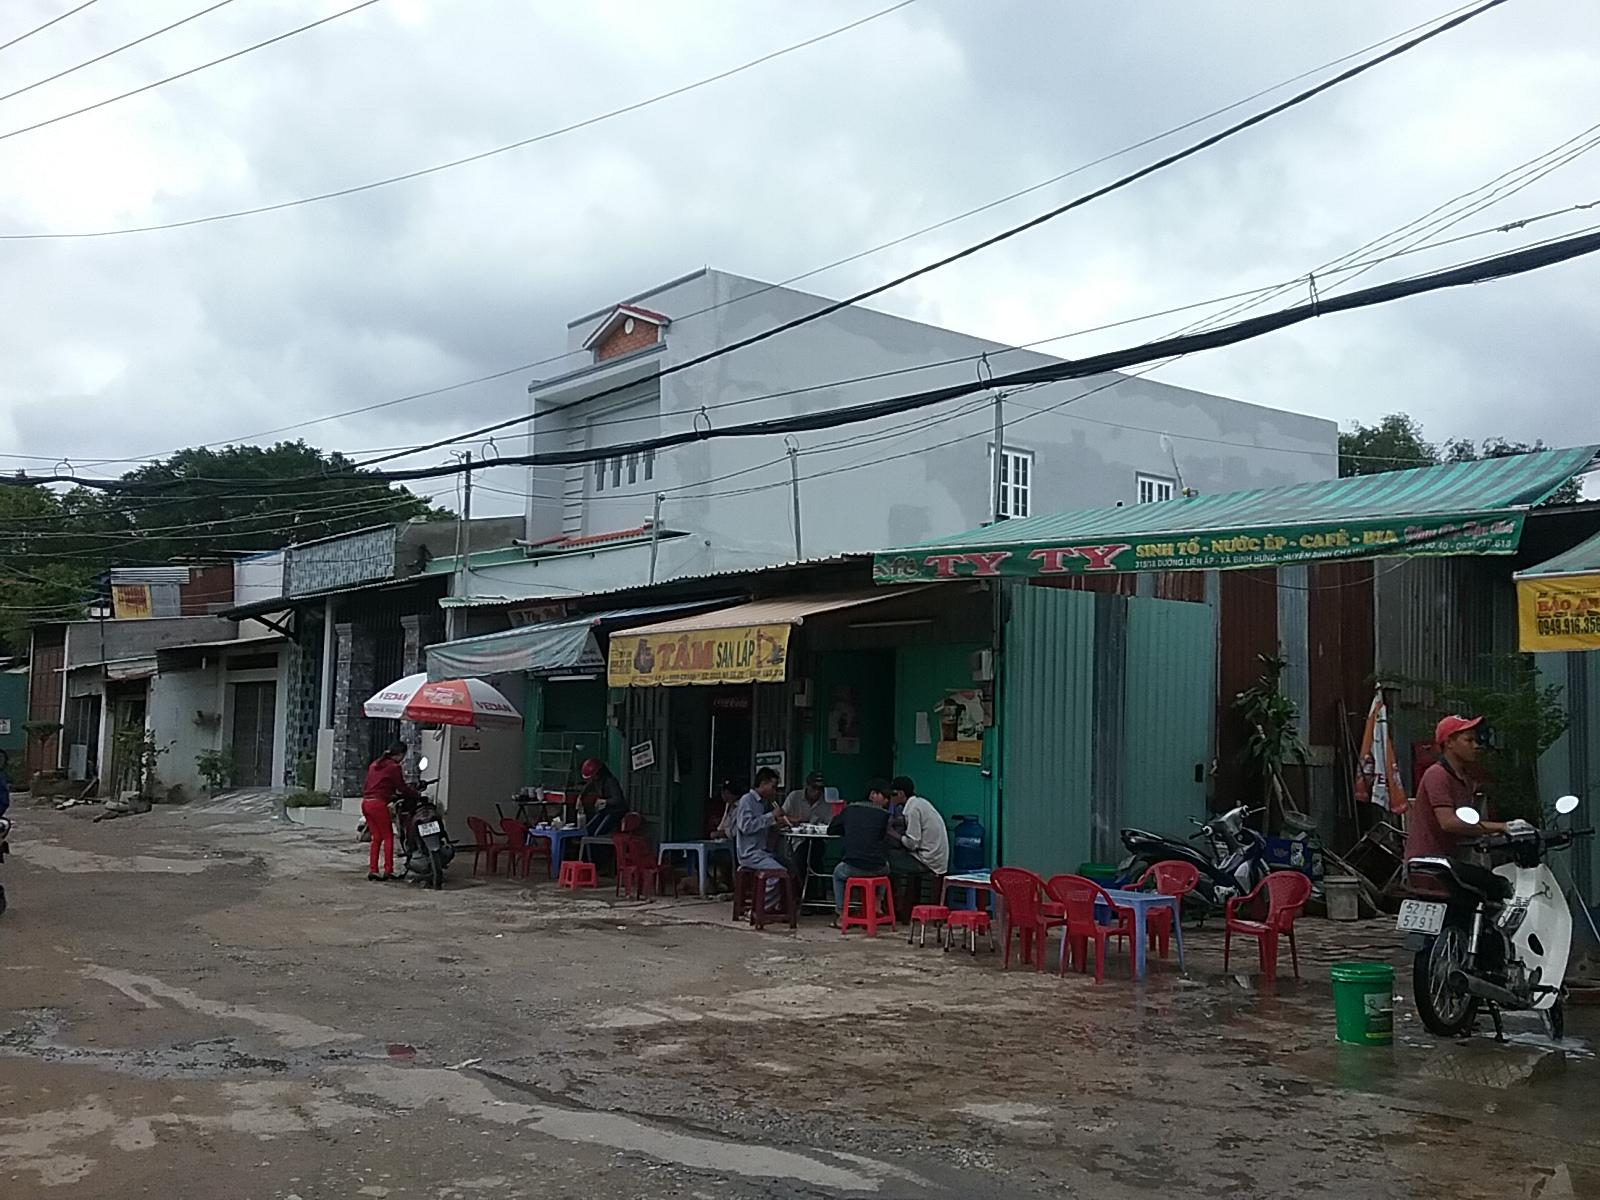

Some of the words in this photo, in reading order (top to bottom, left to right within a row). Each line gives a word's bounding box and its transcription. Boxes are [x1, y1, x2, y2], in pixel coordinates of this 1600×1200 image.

[1136, 543, 1174, 558] SINH
[1176, 536, 1200, 556] TỐ
[924, 551, 1012, 578] TY
[1028, 543, 1132, 573] TY
[475, 701, 512, 713] VEDAN
[1403, 915, 1433, 929] 5791
